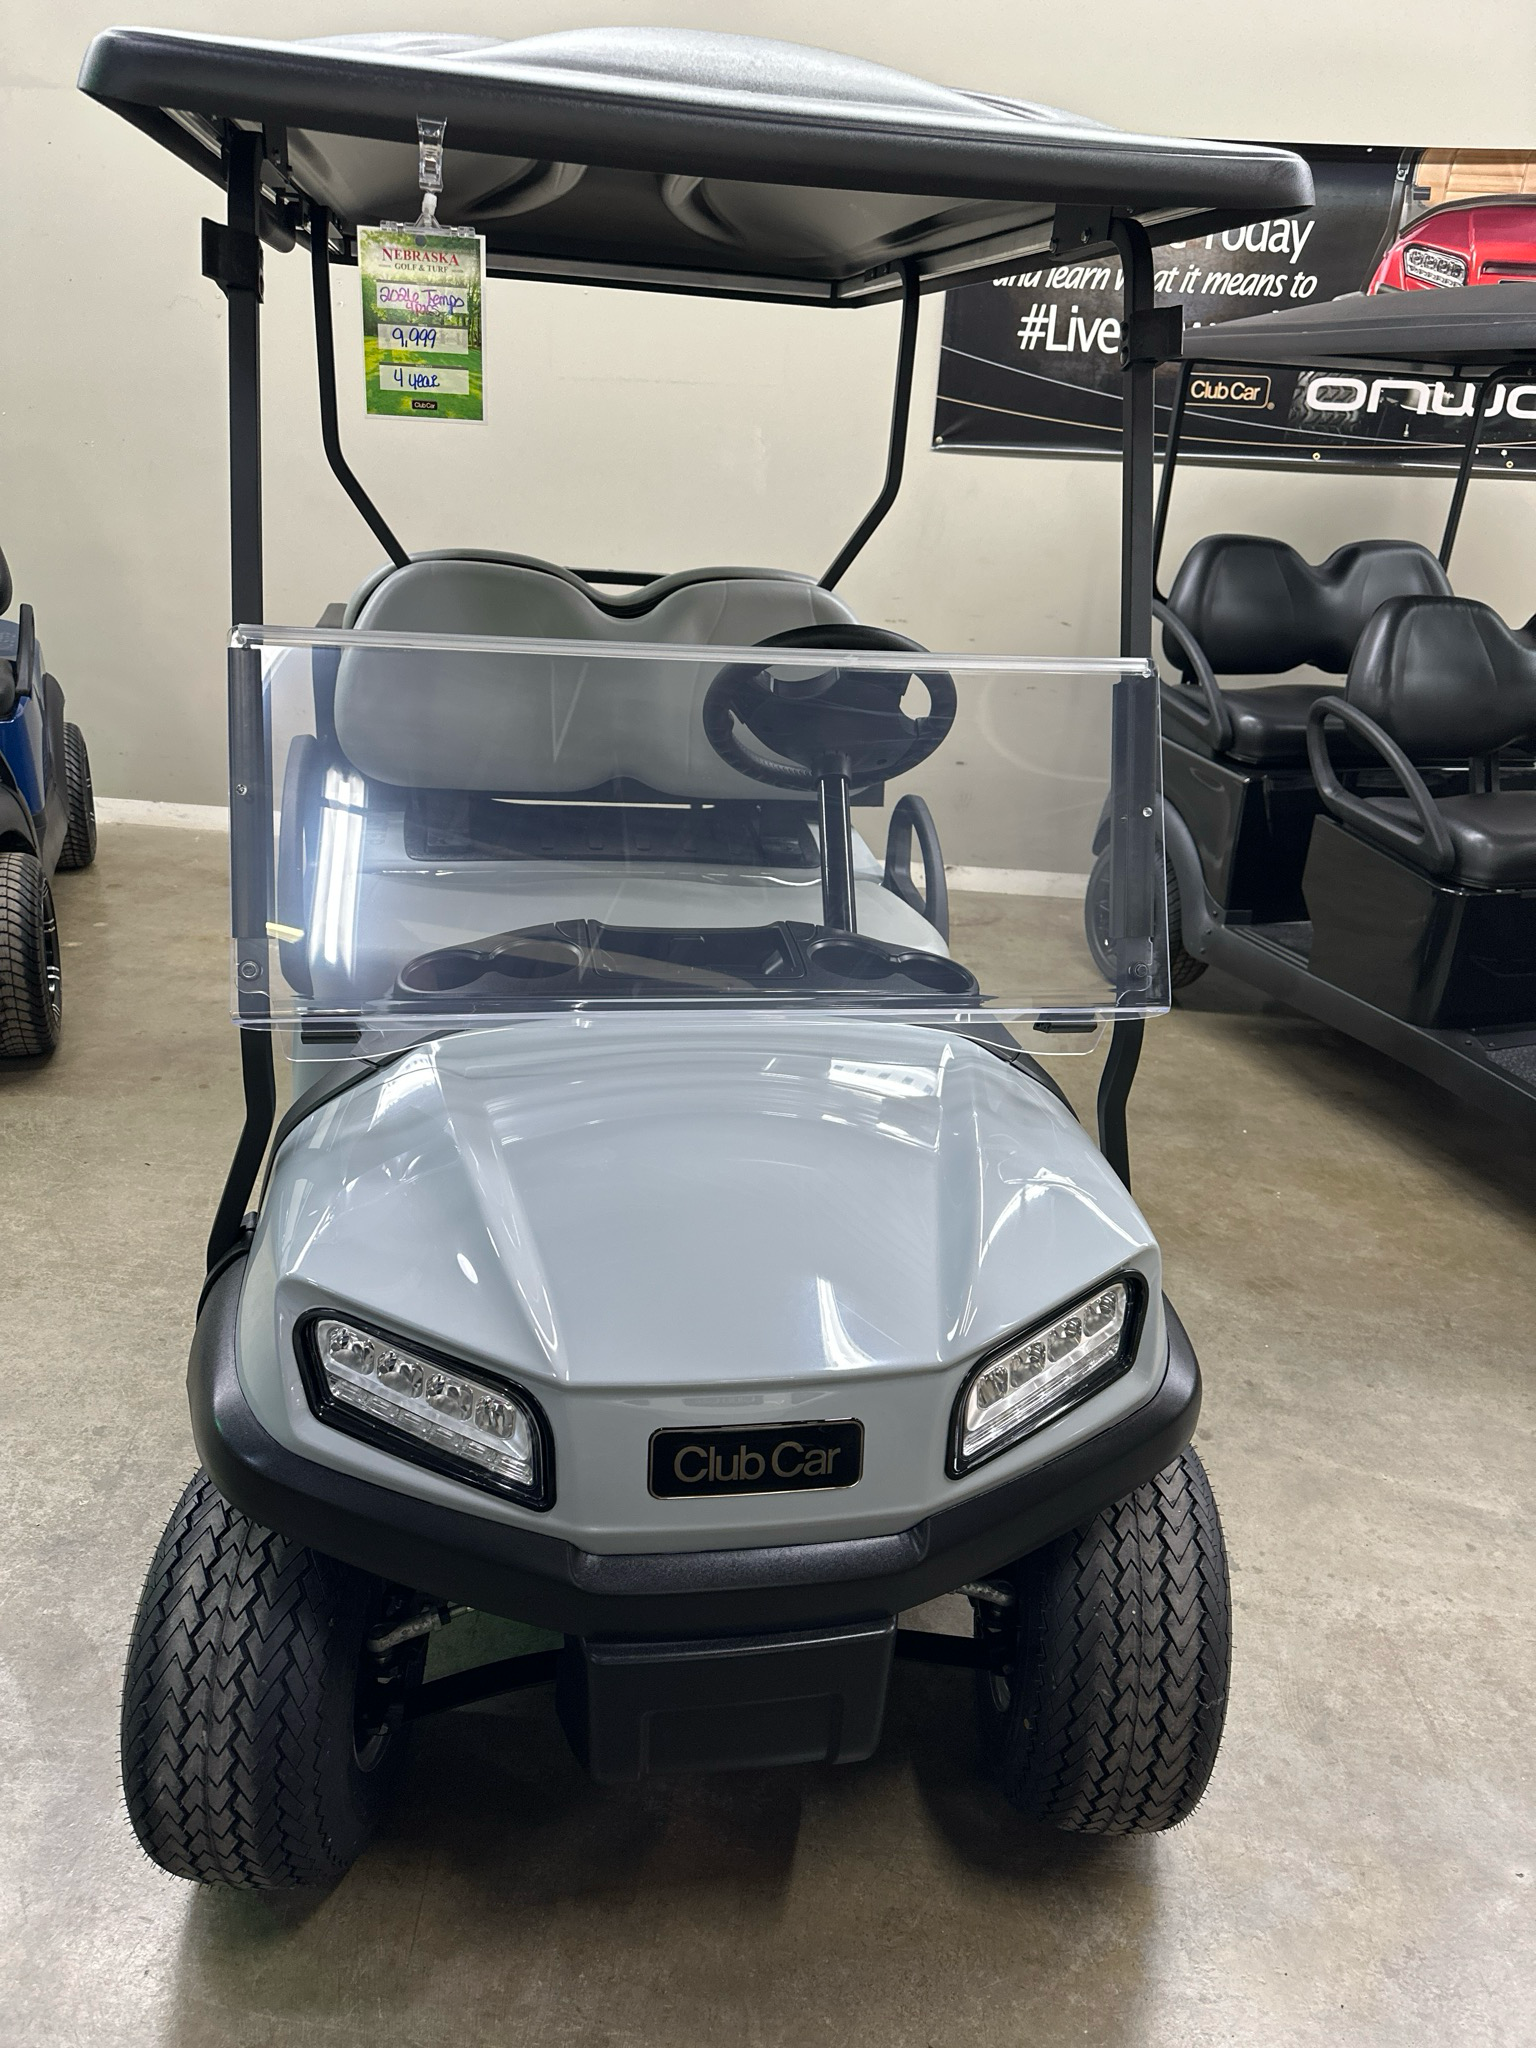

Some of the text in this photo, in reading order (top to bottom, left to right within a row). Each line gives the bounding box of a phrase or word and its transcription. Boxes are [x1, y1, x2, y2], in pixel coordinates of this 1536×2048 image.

[382, 247, 460, 267] NEBRASKA
[394, 262, 417, 271] GOLF
[427, 265, 449, 273] TURF
[1045, 266, 1112, 291] learn
[1179, 264, 1201, 294] it
[1201, 271, 1288, 298] means
[1290, 271, 1318, 299] to
[392, 327, 437, 348] 9,999
[394, 368, 403, 387] 4
[1190, 380, 1261, 401] Club Car
[674, 1441, 841, 1483] Club Car
